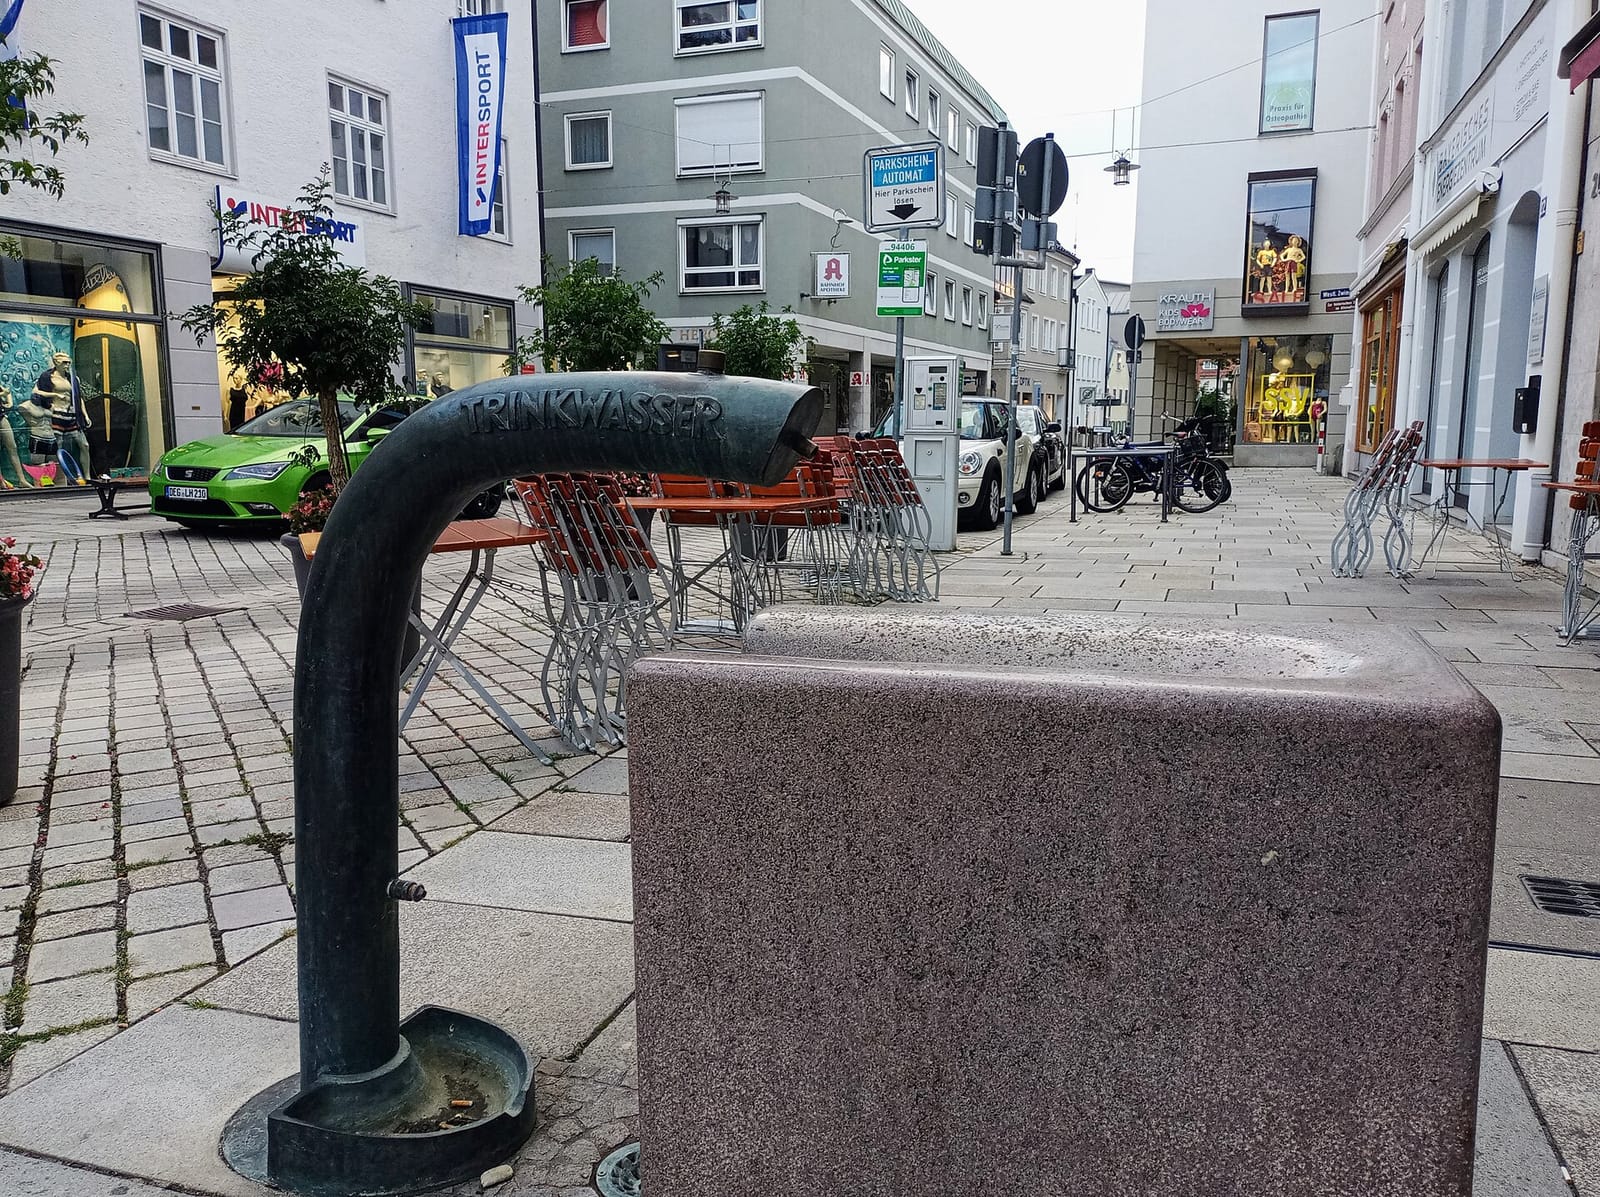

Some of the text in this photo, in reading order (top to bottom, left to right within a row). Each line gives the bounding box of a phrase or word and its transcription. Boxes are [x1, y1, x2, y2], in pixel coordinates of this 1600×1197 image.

[1269, 102, 1305, 113] Praxis für
[475, 50, 492, 186] INTERSPORT
[1265, 112, 1308, 122] Osteopathie
[874, 153, 934, 172] PARKSCHEIN-
[882, 168, 924, 185] AUTOMAT
[874, 185, 935, 198] Hier Parkschein
[249, 201, 357, 244] INTERSPORT
[890, 243, 916, 251] 94406
[893, 256, 922, 264] Parkster
[1159, 292, 1212, 304] KRAUTH
[1252, 288, 1306, 304] SALE
[1159, 308, 1180, 318] KIDS
[1158, 317, 1204, 327] BODYWEAR
[1263, 387, 1310, 411] SSV
[461, 389, 728, 441] TRINKWASSER
